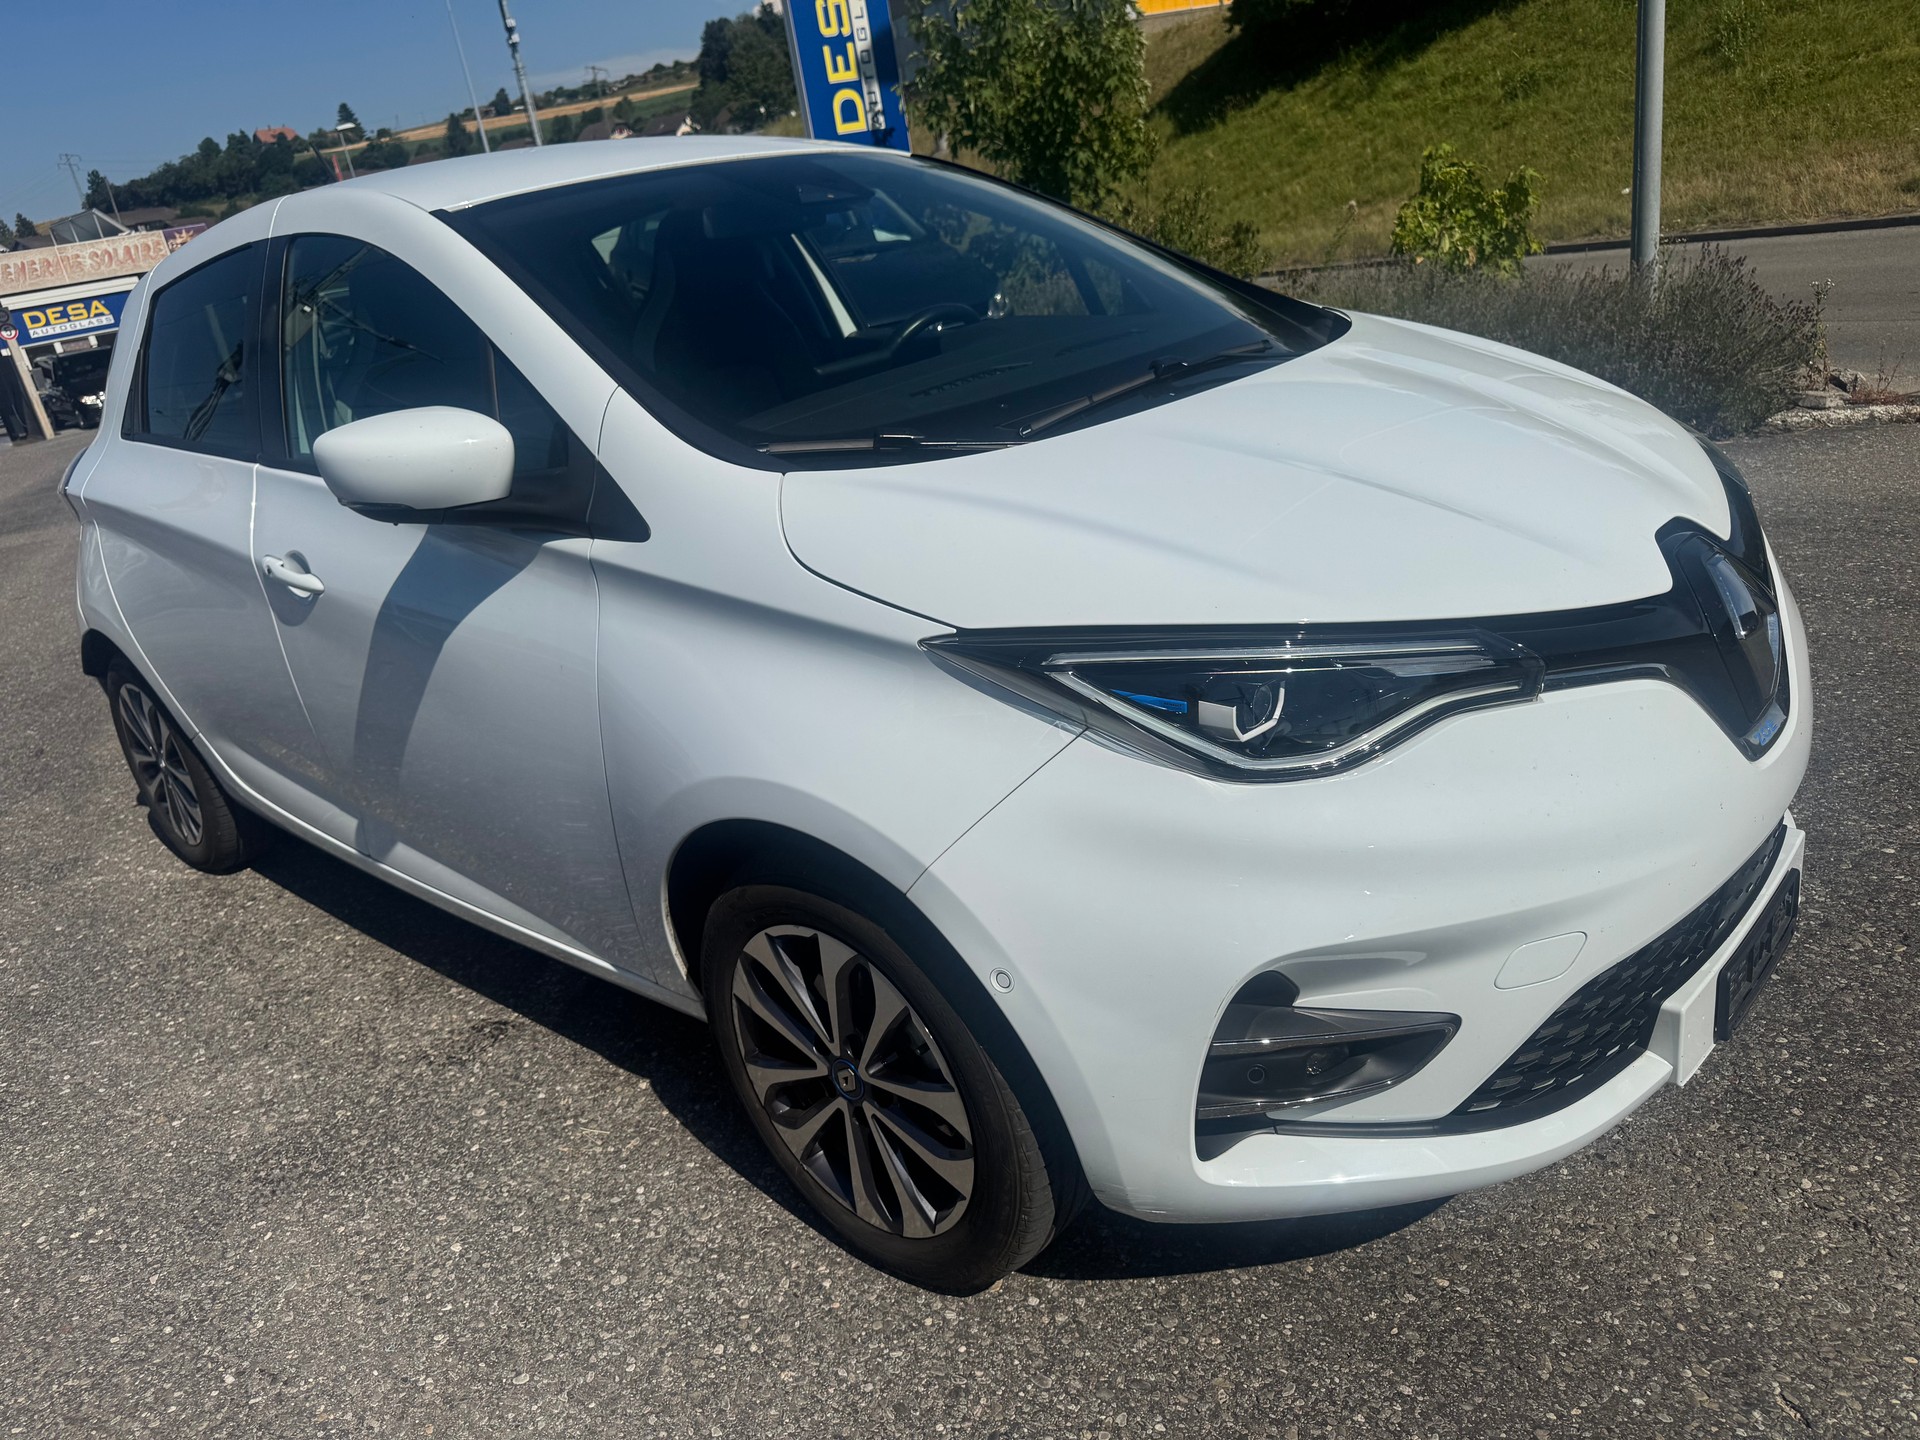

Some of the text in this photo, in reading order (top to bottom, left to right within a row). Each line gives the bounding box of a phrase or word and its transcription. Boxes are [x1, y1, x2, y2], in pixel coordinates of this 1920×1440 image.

[88, 239, 166, 271] SOLAIRE
[22, 300, 111, 330] DESA
[31, 316, 113, 337] AUTOGLASS
